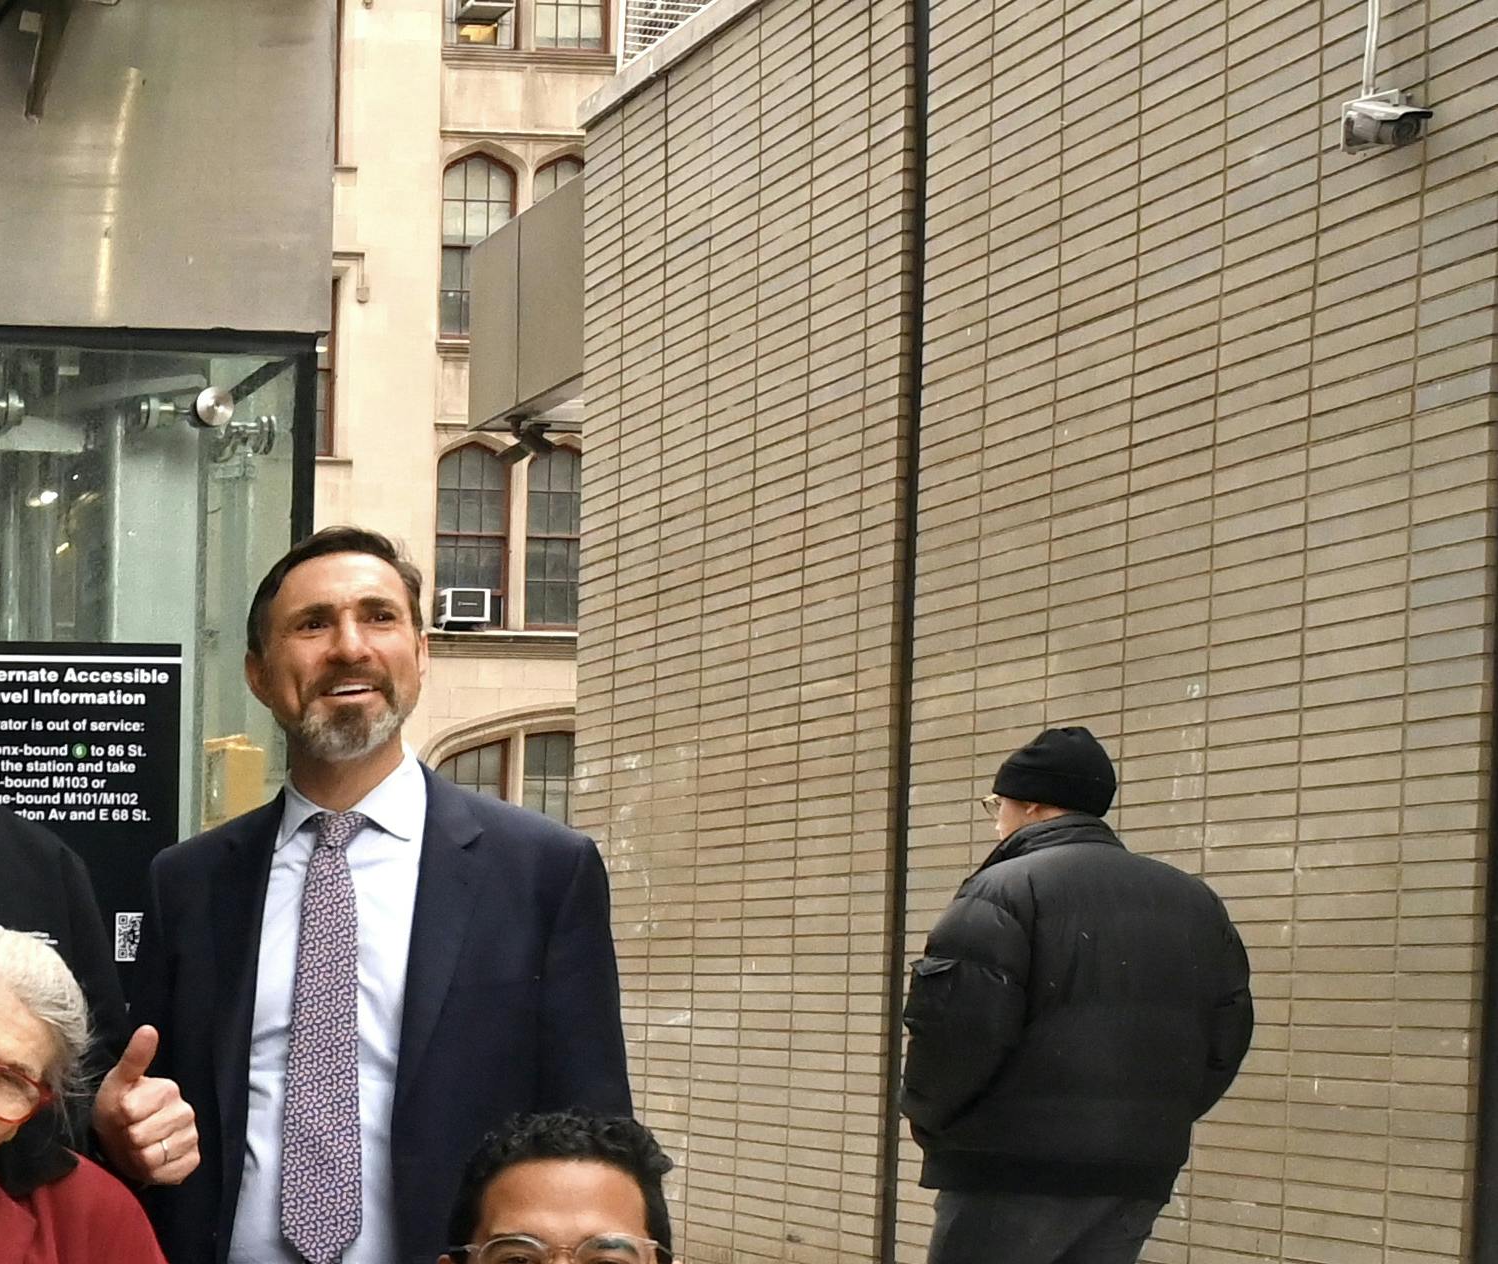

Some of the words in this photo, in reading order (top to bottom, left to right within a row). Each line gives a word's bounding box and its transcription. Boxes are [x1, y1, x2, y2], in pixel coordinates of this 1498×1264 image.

[64, 668, 169, 684] Accessible
[34, 689, 146, 705] Information
[31, 717, 43, 731] is
[46, 718, 69, 731] out
[72, 718, 87, 731] of
[90, 718, 145, 732] service:
[91, 744, 104, 757] to
[108, 744, 125, 757] 86
[128, 744, 147, 757] St.
[1, 760, 23, 772] the
[26, 760, 74, 772] station
[77, 761, 103, 773] and
[107, 761, 136, 773] take
[53, 776, 88, 789] M103
[91, 778, 106, 789] or
[64, 792, 139, 805] M101/M102
[48, 808, 66, 820] Av
[69, 808, 95, 820] and
[99, 808, 109, 820] E
[112, 809, 129, 821] 68
[132, 809, 151, 821] St.
